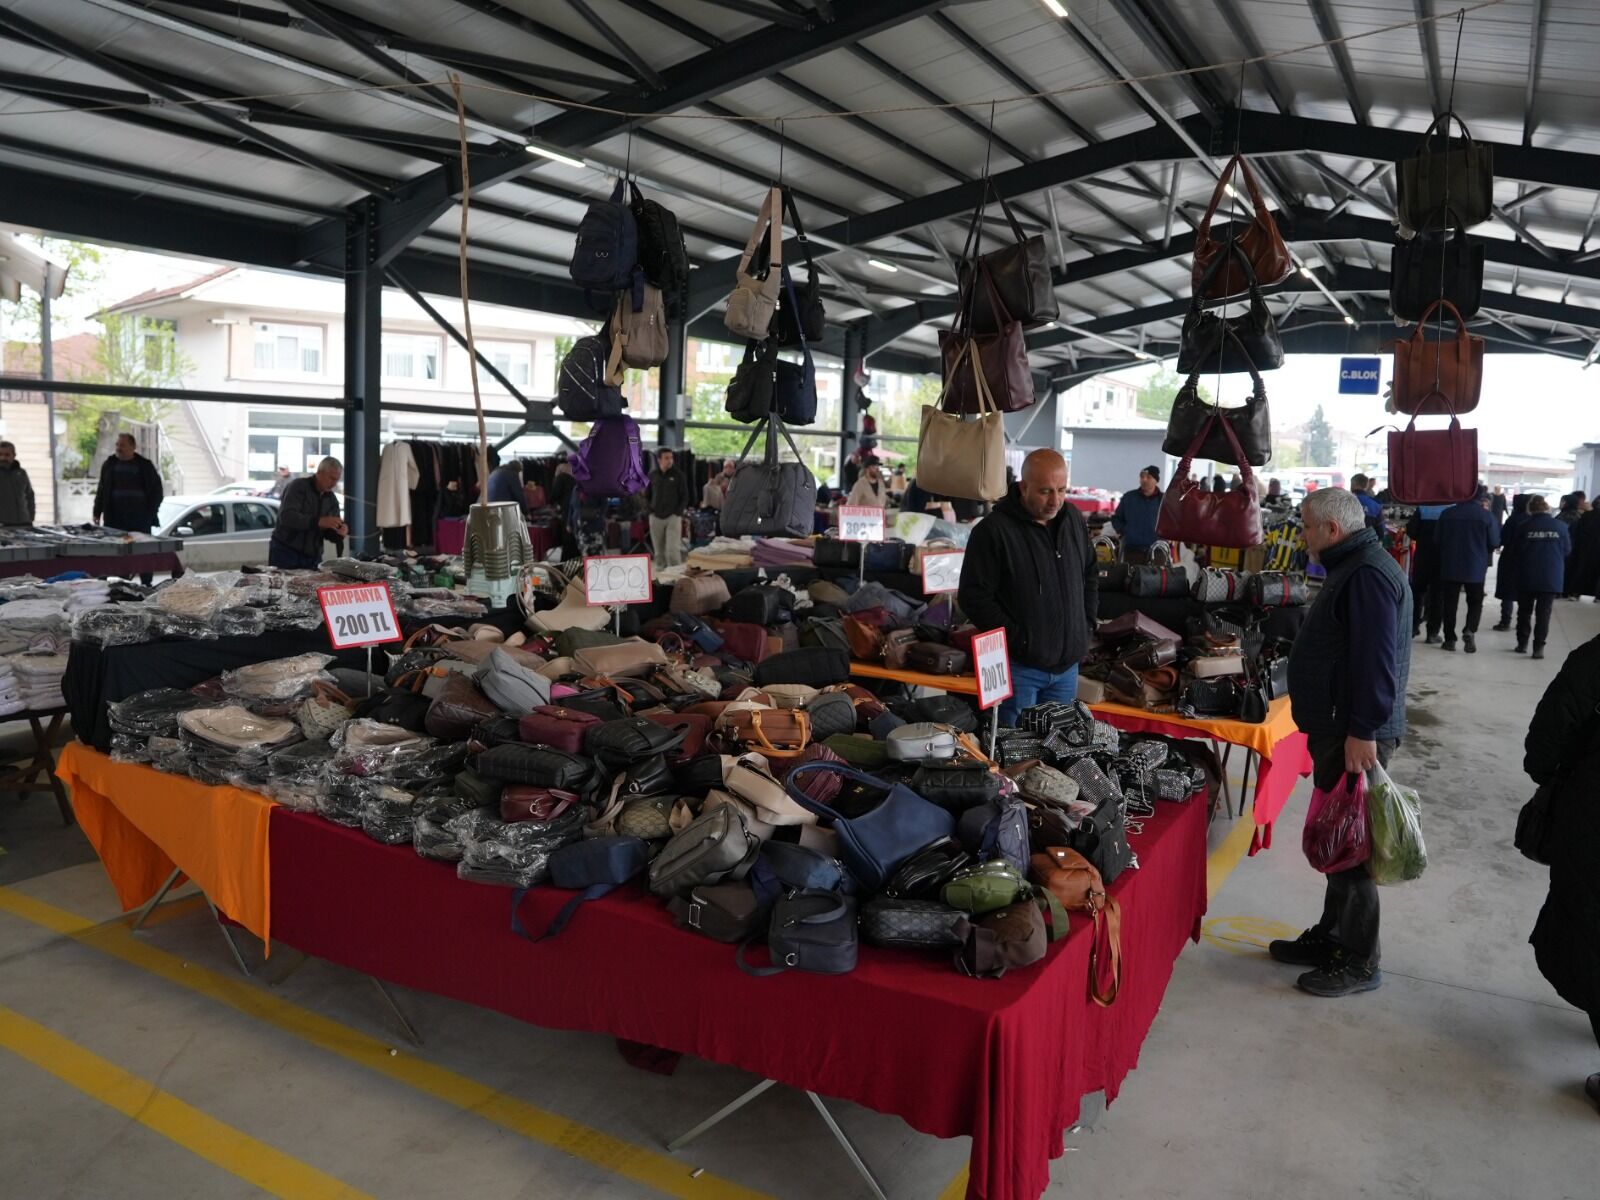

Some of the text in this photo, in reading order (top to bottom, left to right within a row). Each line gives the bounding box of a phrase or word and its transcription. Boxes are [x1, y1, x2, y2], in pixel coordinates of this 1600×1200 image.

[1341, 369, 1378, 380] C.BLOK
[588, 564, 645, 591] 200
[321, 587, 383, 606] KAMPANYA
[335, 611, 391, 637] 200 TL
[981, 662, 1007, 693] 200 TL
